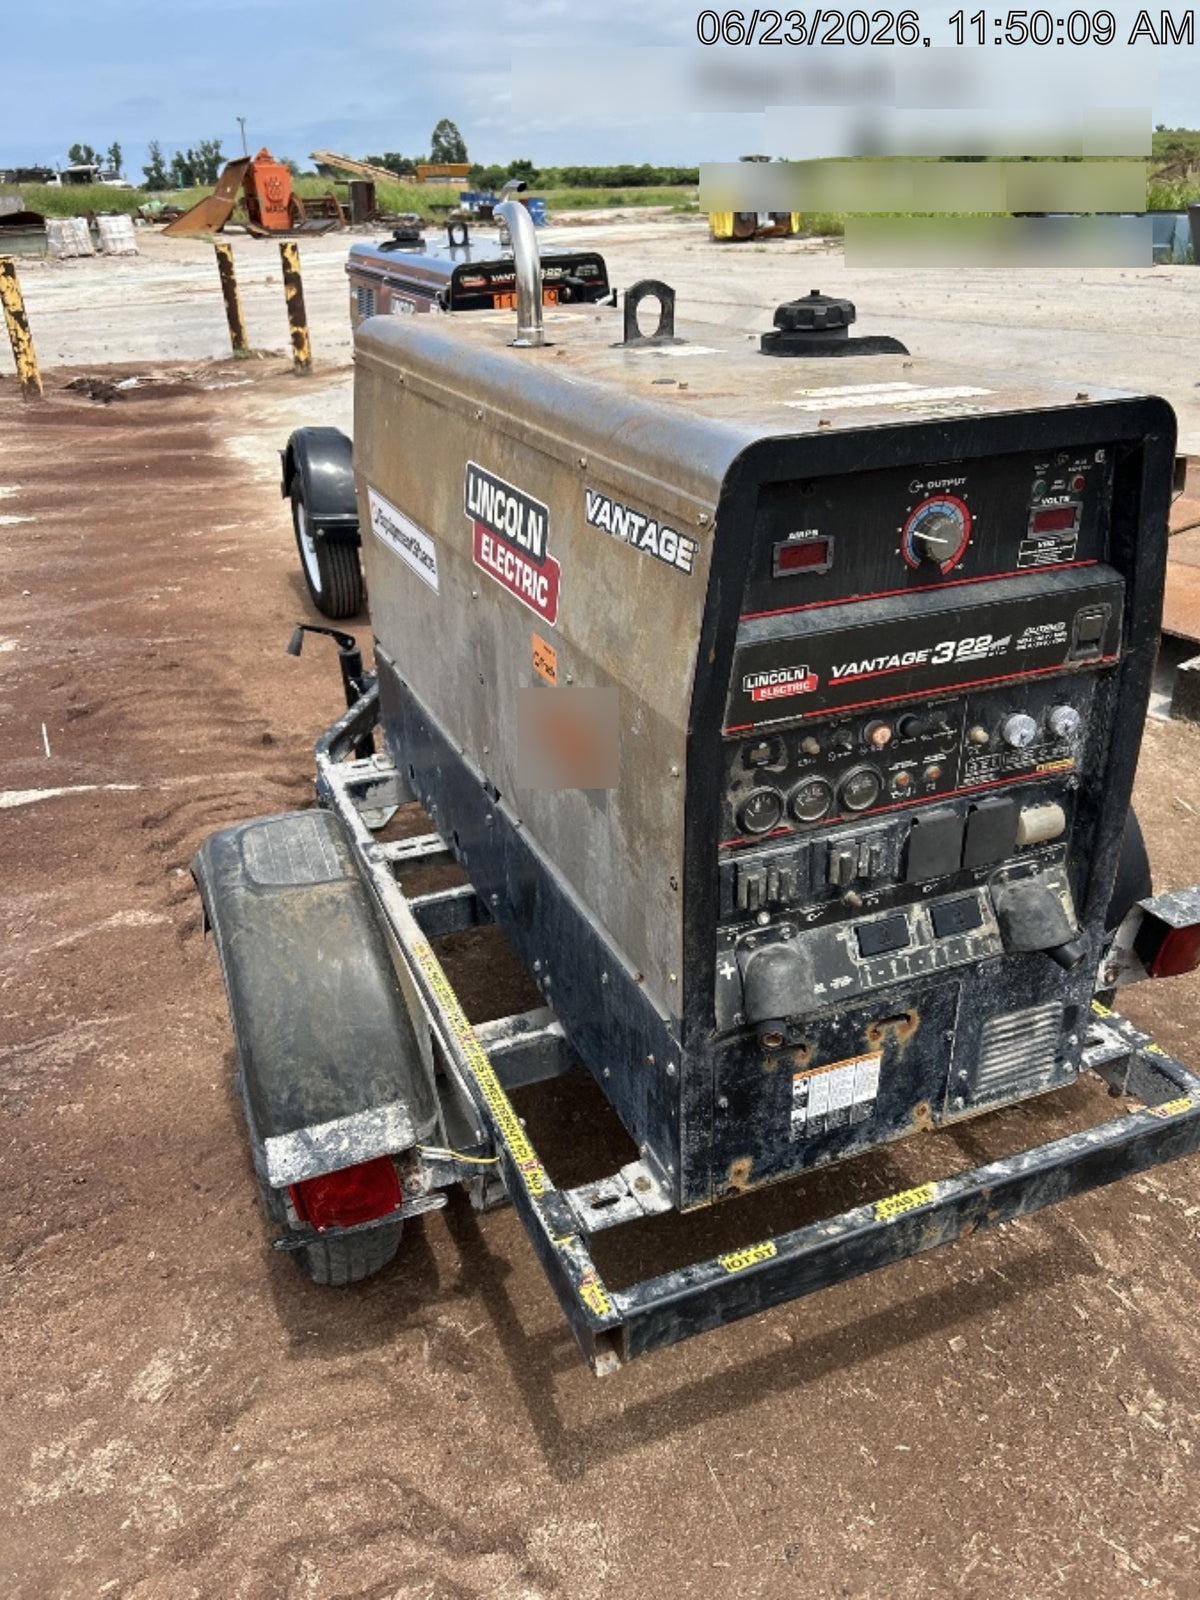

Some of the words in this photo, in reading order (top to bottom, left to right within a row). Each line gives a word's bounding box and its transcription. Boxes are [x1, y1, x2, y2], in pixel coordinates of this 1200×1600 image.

[927, 477, 968, 489] OUTPUT
[468, 472, 544, 557] LINCOLN
[585, 488, 697, 573] VANTAGE
[480, 532, 549, 608] ELECTRIC
[746, 668, 805, 689] LINCOLN
[831, 649, 930, 678] VANTAGE
[930, 634, 993, 665] 322
